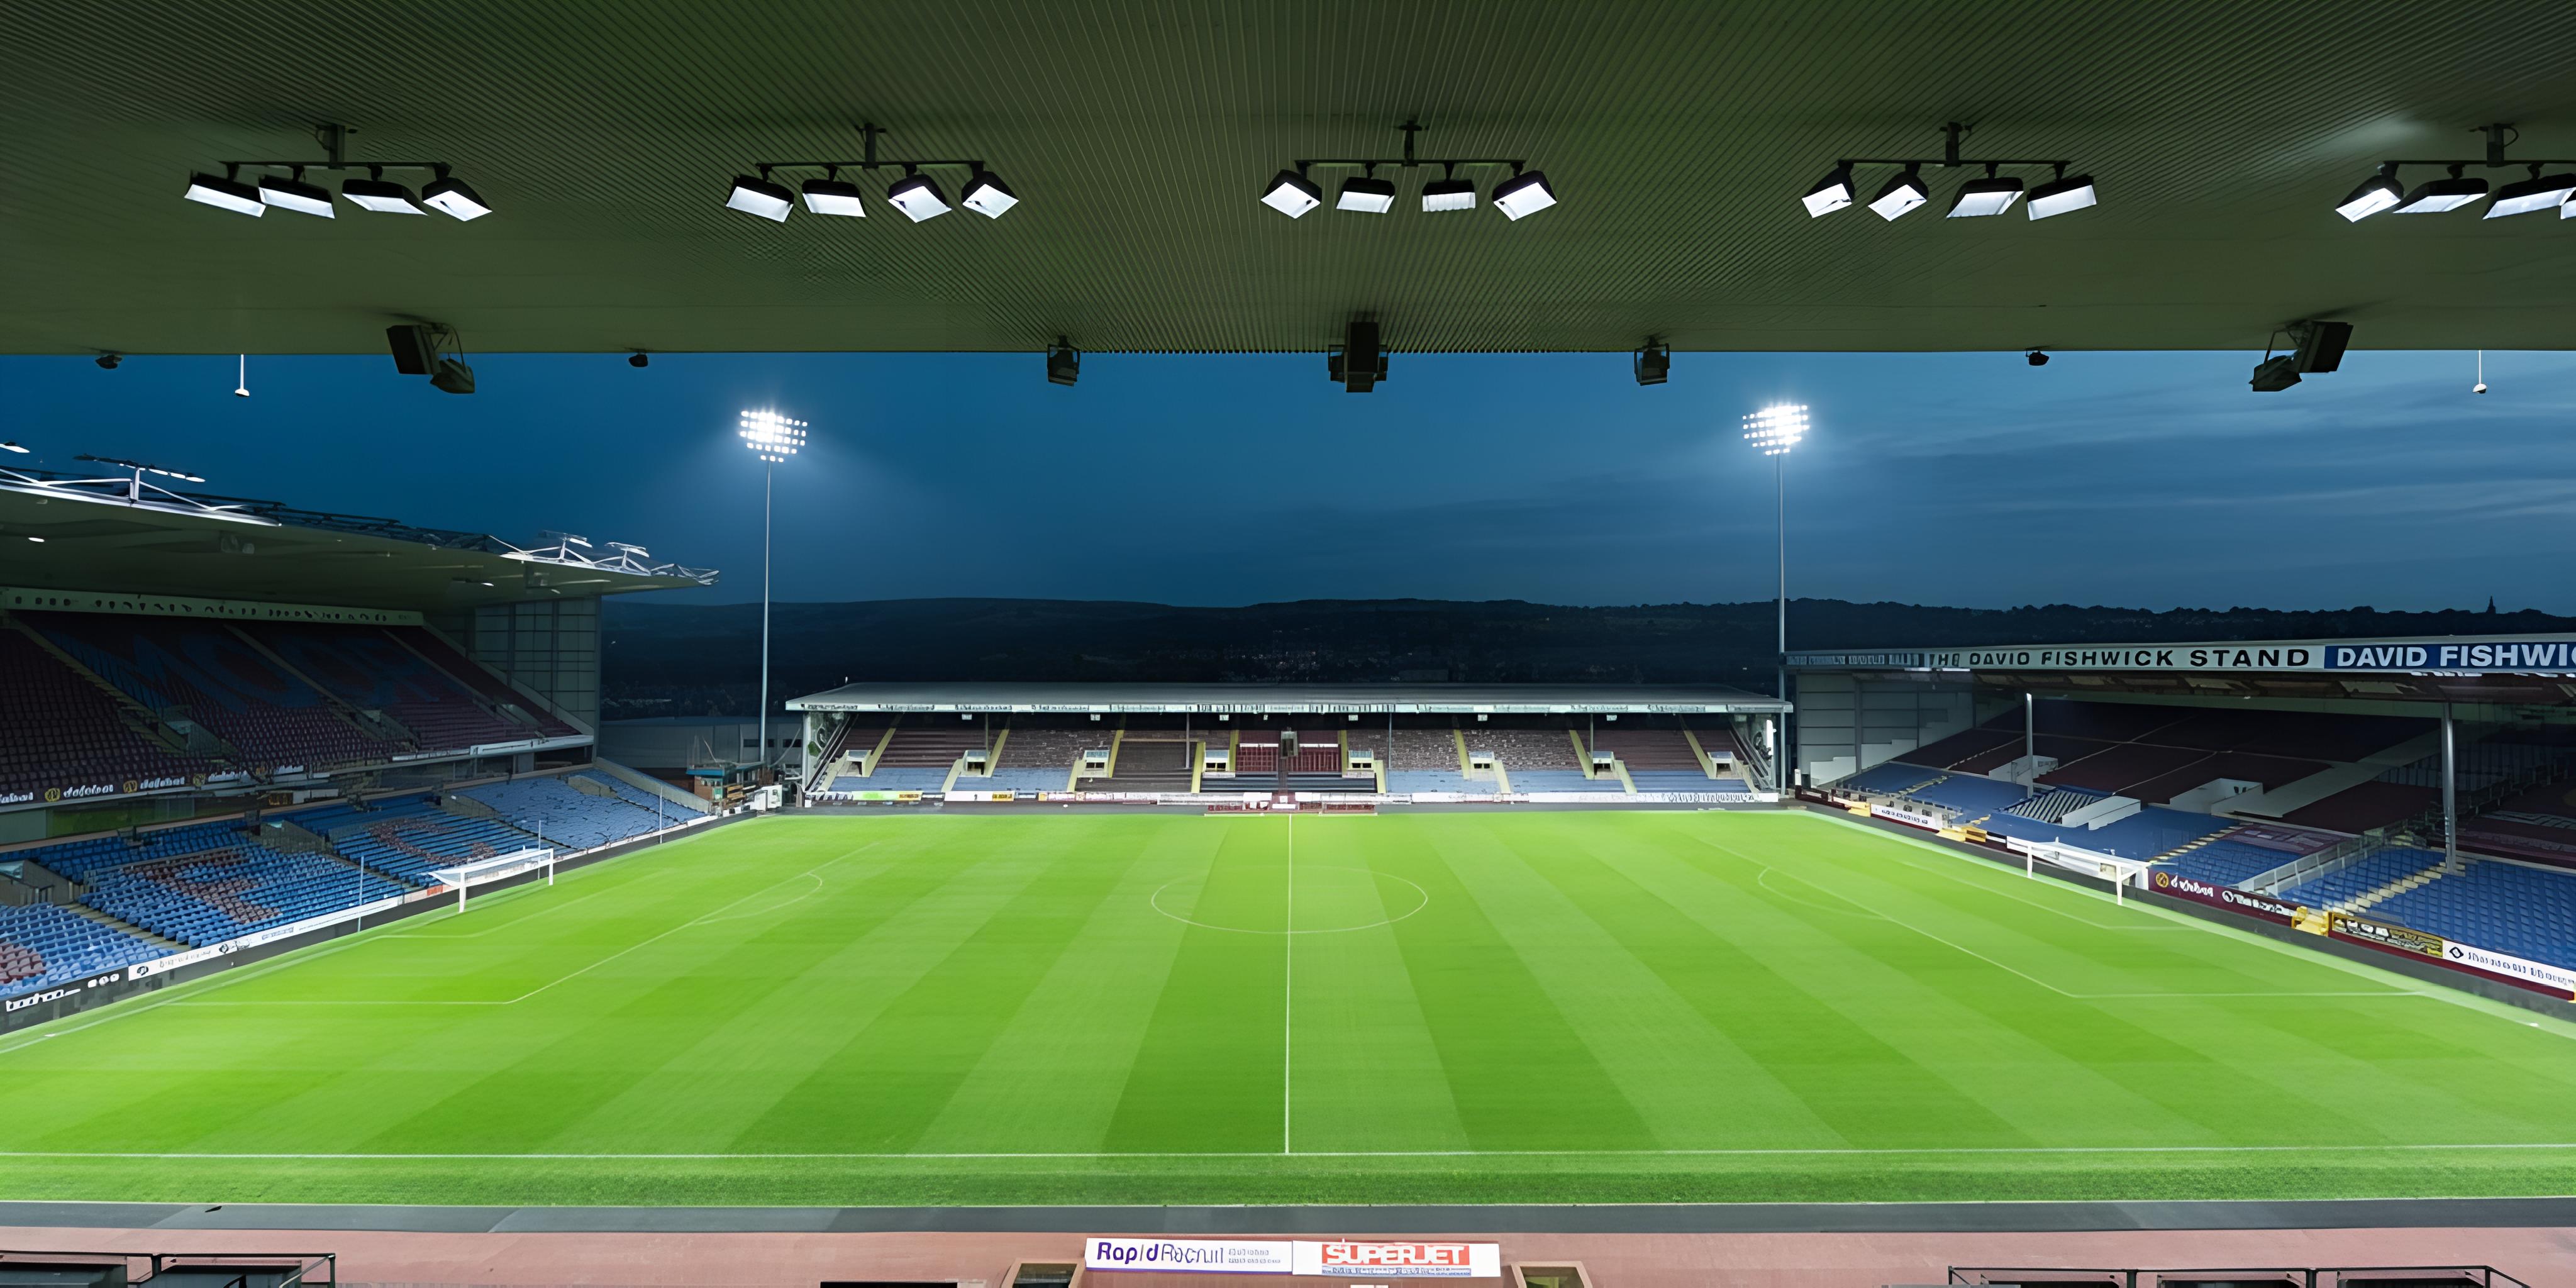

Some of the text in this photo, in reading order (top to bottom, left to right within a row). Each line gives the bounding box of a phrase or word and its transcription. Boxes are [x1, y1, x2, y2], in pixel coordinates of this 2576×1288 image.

[1969, 652, 2030, 667] DAVID
[2041, 650, 2174, 667] FISHWICK
[2190, 649, 2309, 667] STAND
[2337, 644, 2576, 667] DAVID FISHWI
[1325, 1245, 1466, 1265] SUPERJET
